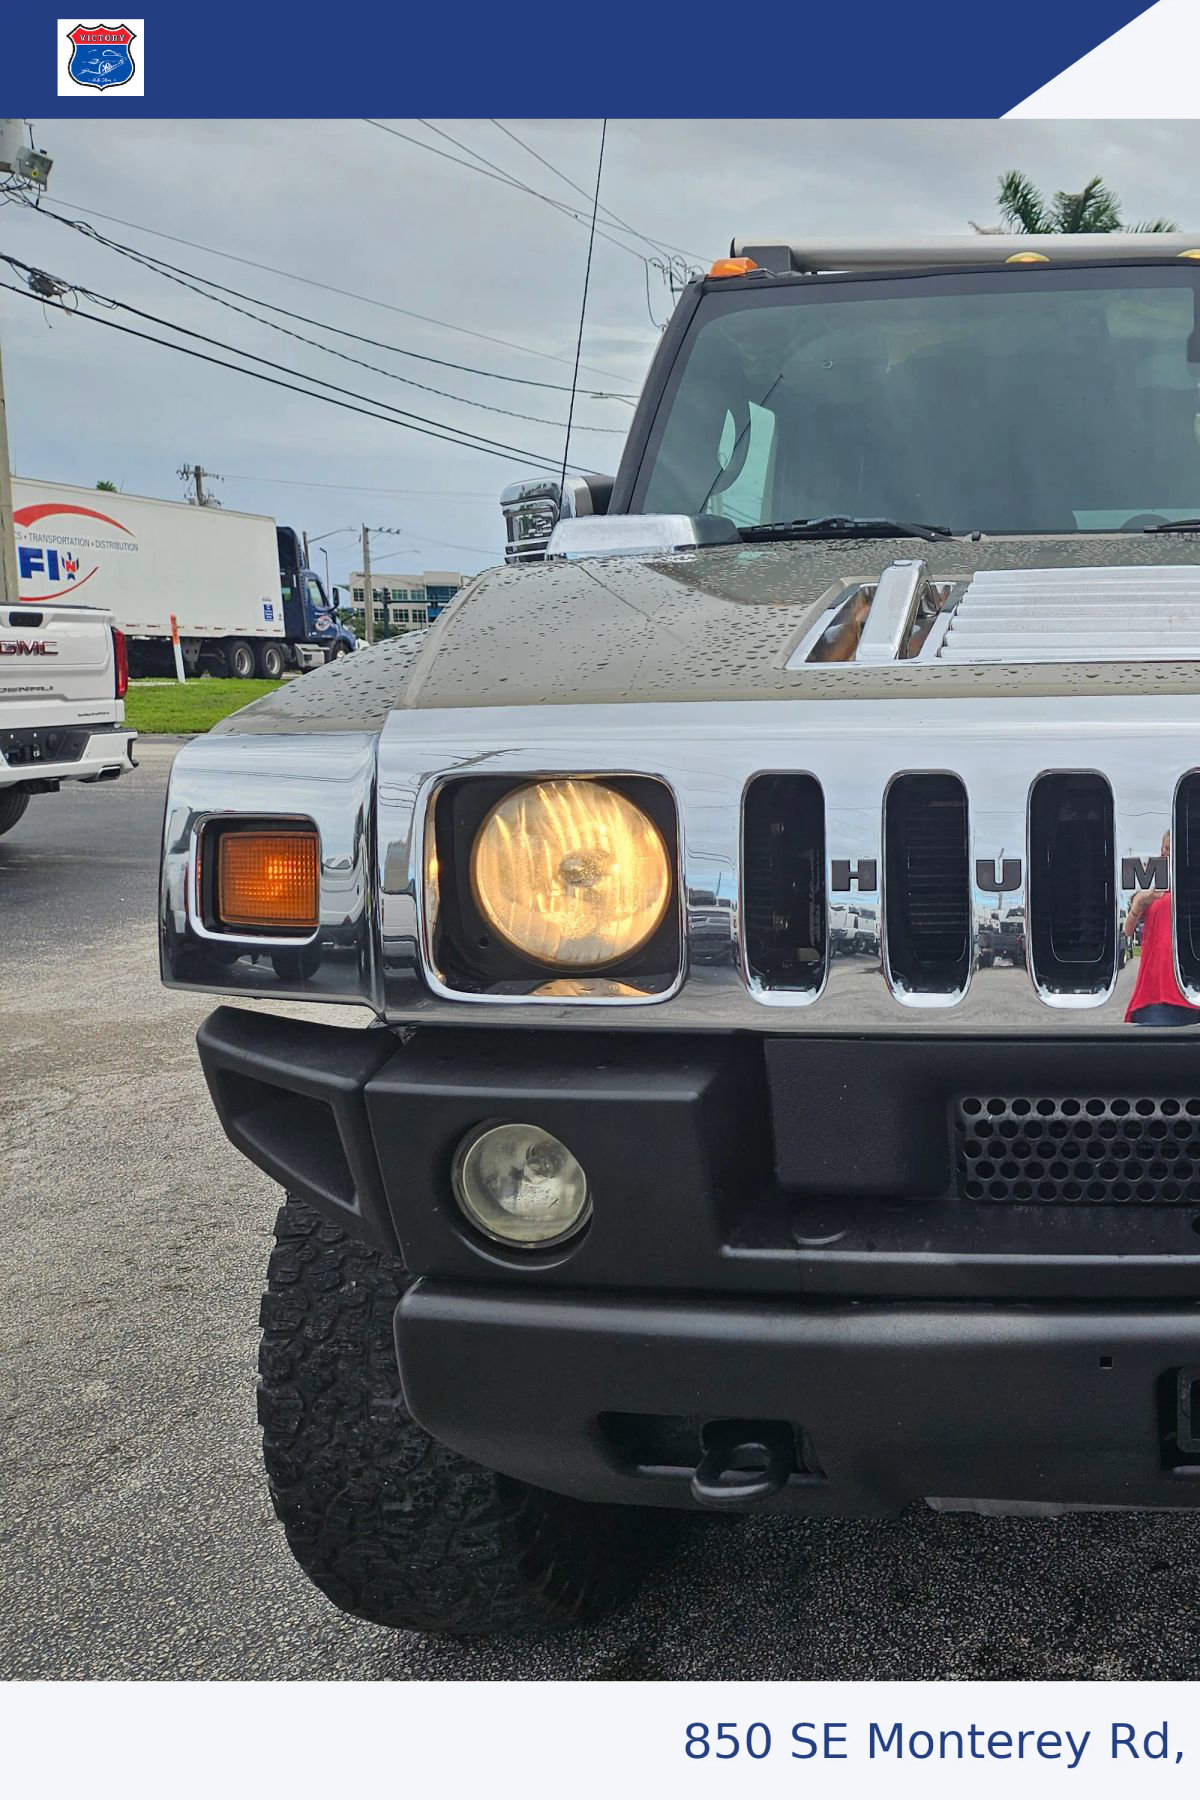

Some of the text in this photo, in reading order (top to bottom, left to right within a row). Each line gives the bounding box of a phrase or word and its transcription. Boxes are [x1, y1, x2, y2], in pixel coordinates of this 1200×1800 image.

[28, 532, 91, 548] TRANSPORTATION
[95, 539, 139, 552] DISTRIBUTION
[0, 640, 58, 656] GMC
